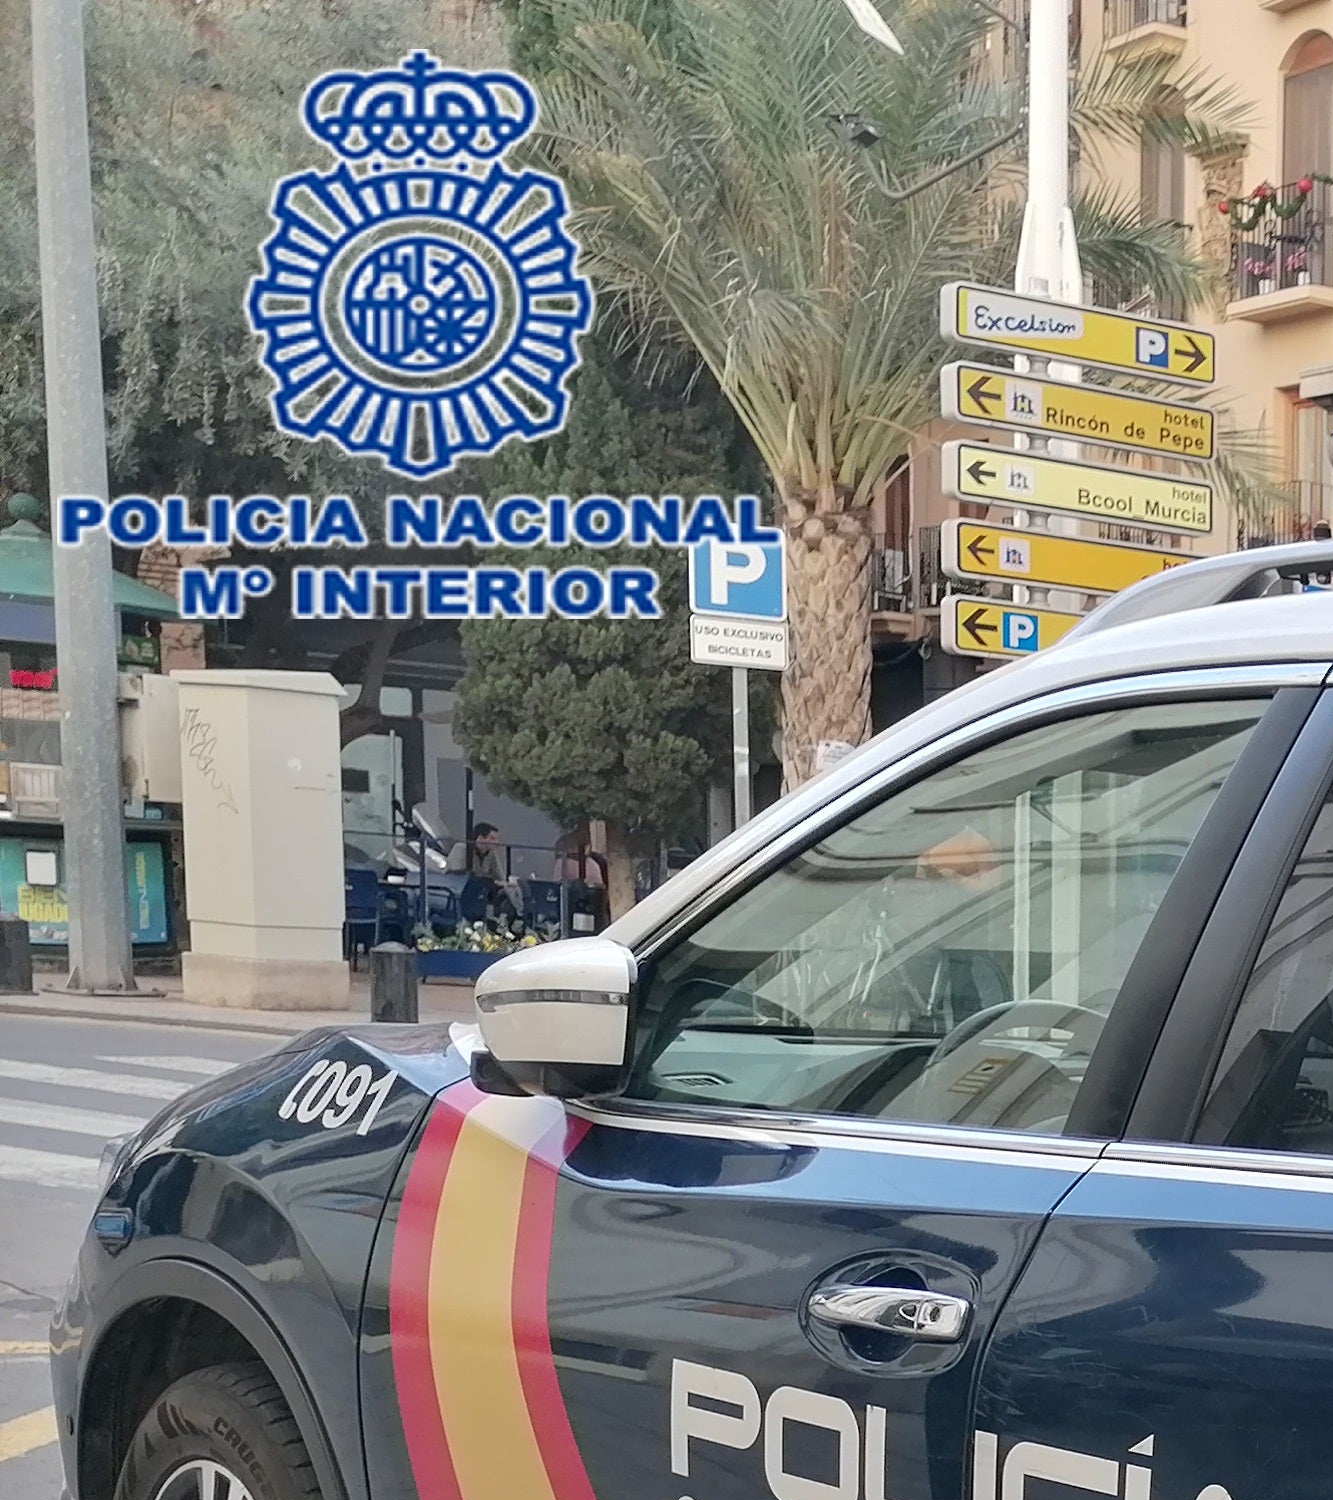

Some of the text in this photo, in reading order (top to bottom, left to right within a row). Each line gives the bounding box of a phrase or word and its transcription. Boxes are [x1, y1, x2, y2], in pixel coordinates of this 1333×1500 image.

[1046, 407, 1205, 451] Rincón de Pepe
[1164, 409, 1205, 431] hotel
[1172, 486, 1207, 505] hotel
[1145, 499, 1207, 525] Murcia
[695, 626, 784, 643] USO EXCLUSIVO
[708, 645, 773, 659] BICICLETAS
